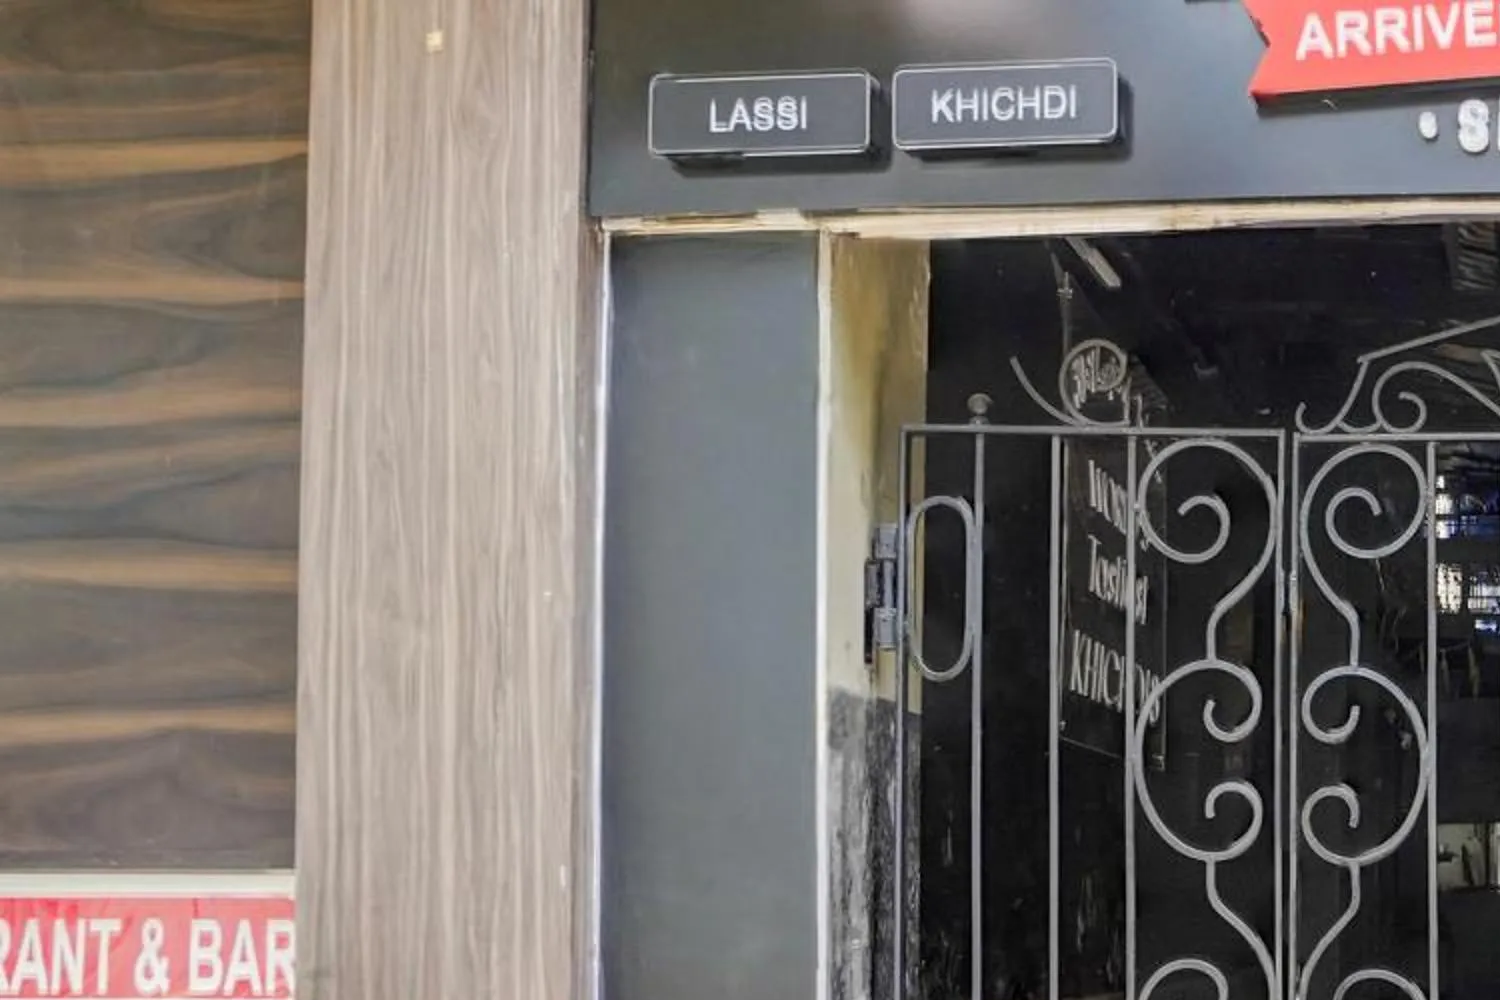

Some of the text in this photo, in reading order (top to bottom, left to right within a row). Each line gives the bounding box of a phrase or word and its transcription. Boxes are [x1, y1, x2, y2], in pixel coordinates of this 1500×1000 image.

[709, 96, 808, 134] LASSI
[930, 85, 1078, 124] KHICHDI
[1087, 533, 1149, 625] Tastist
[133, 917, 172, 996] &
[187, 918, 295, 997] BAR
